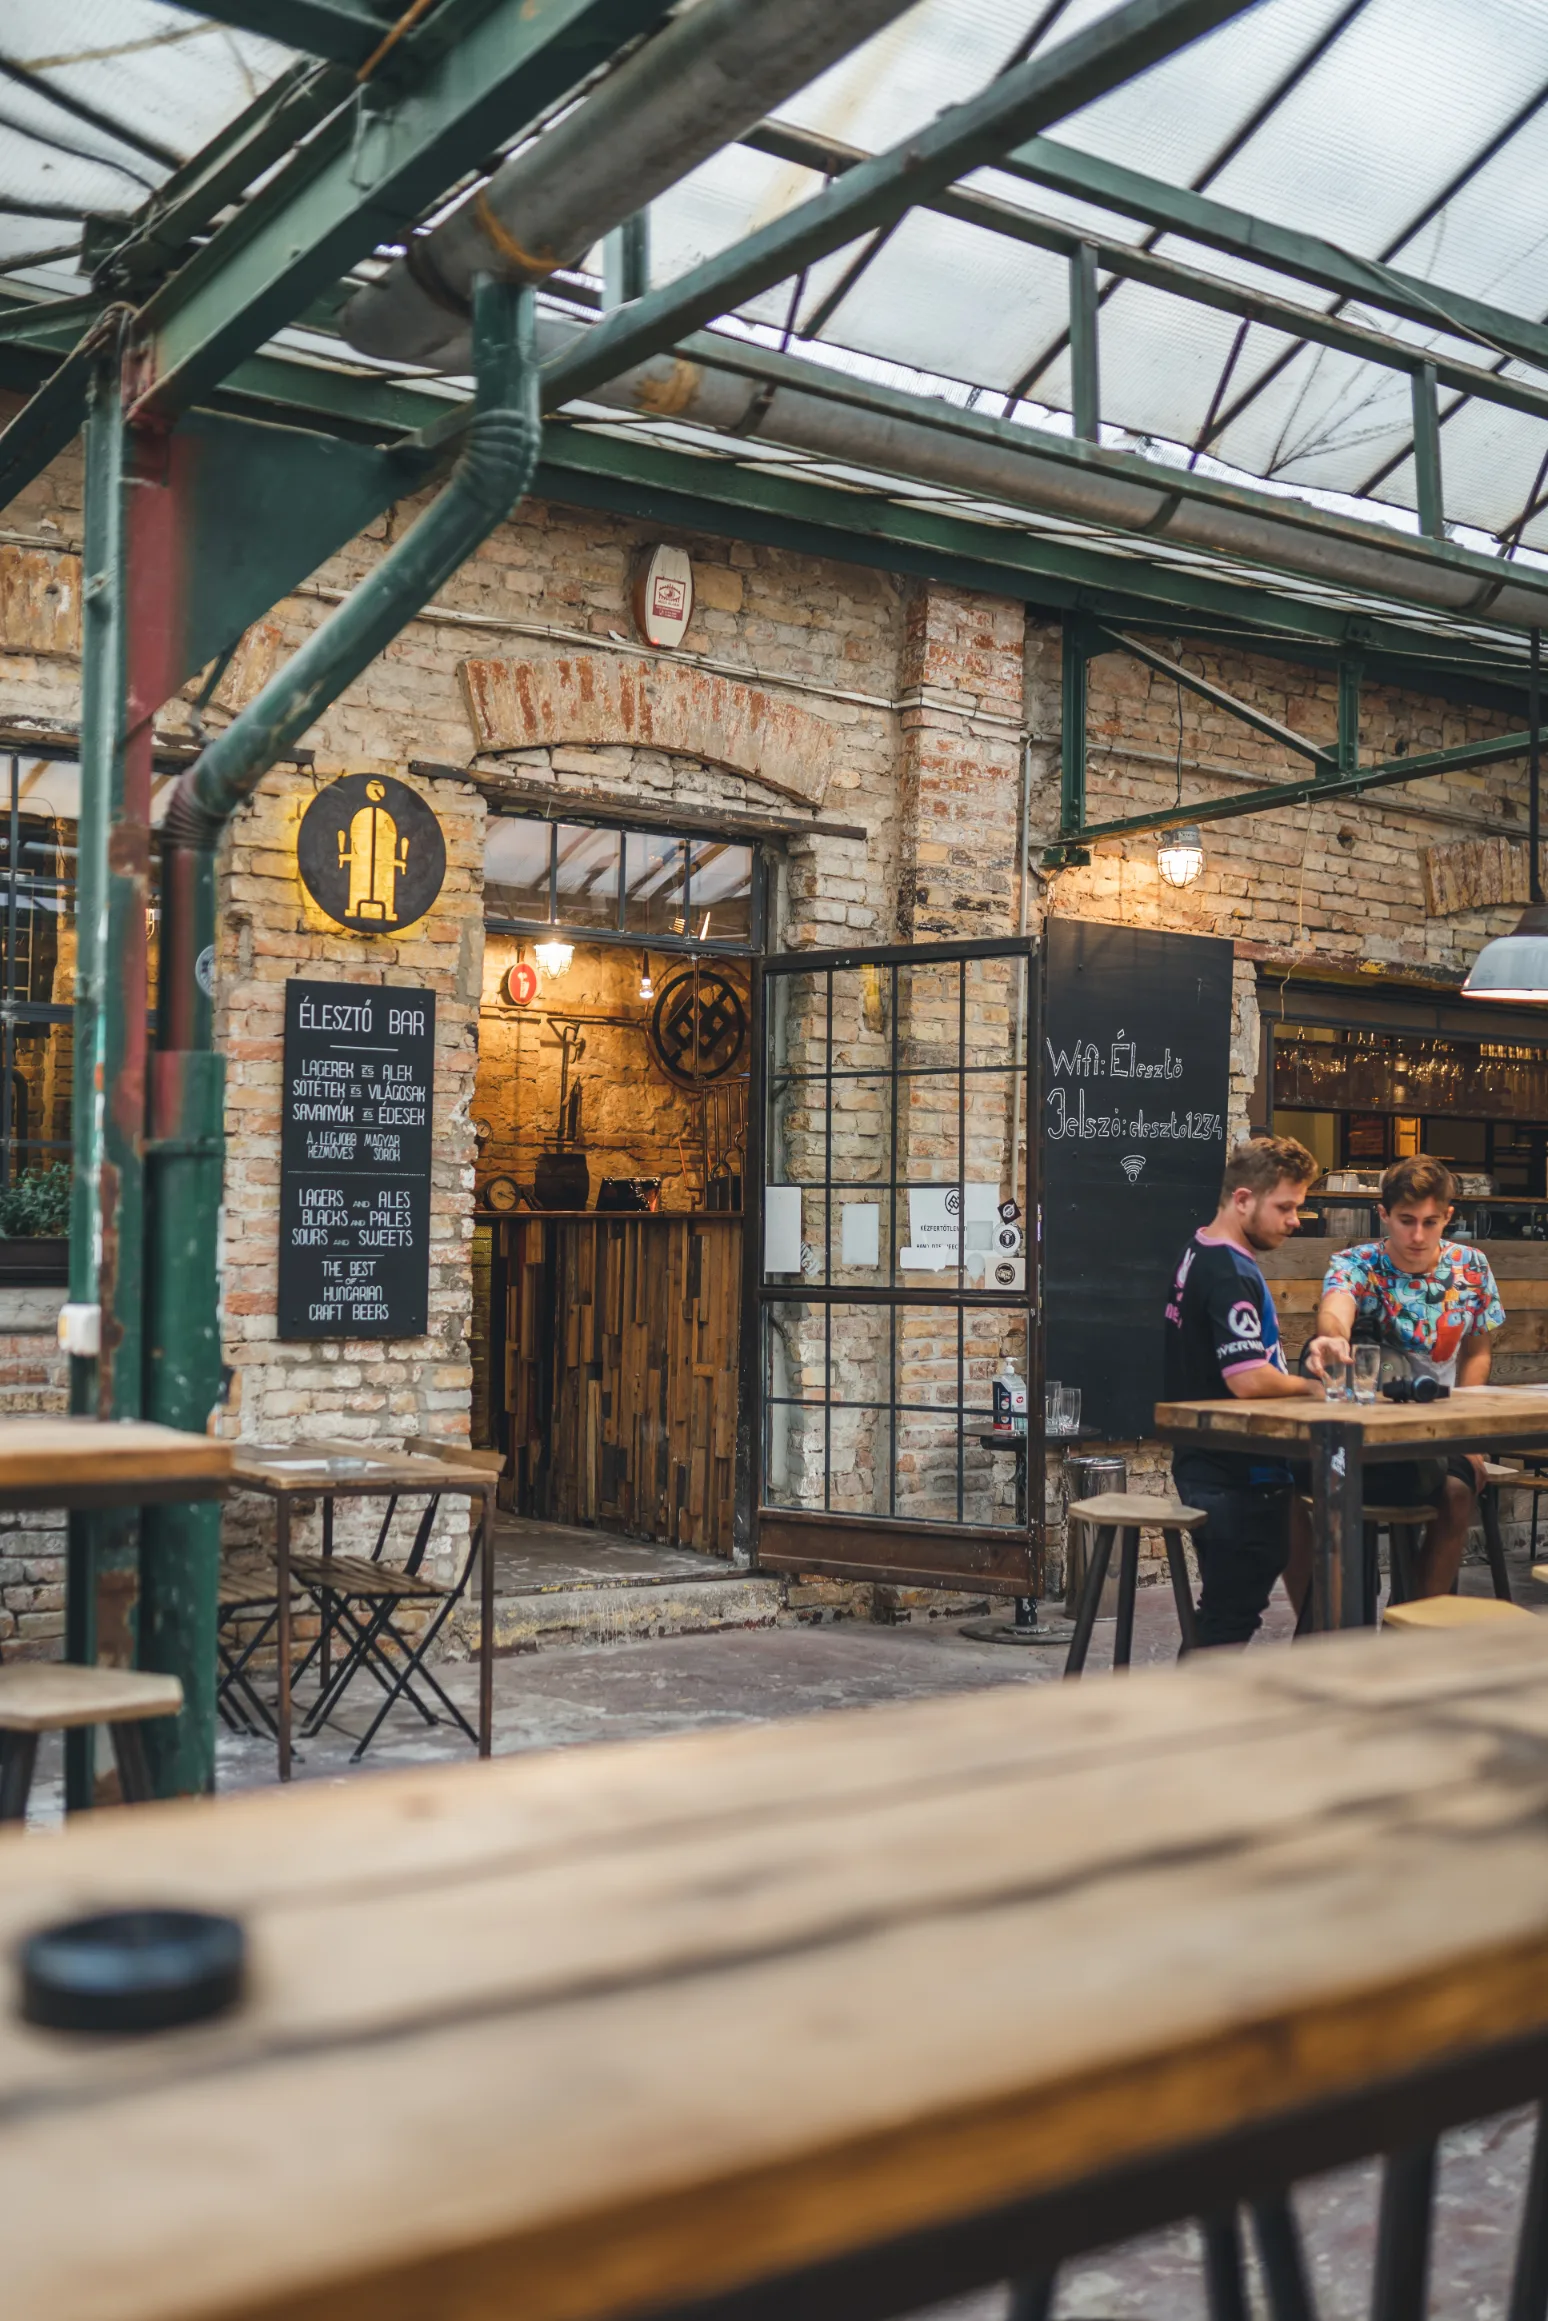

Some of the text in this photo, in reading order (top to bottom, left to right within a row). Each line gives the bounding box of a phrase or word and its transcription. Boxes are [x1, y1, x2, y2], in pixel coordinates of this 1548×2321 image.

[299, 995, 425, 1036] ÉLESZTŐ BAR
[1046, 1037, 1106, 1077] Wifi:
[302, 1059, 354, 1079] LAGEREK
[382, 1064, 412, 1081] ALEK
[368, 1081, 426, 1102] VILÁGOSAK
[292, 1099, 354, 1122] SAVANYÚK
[378, 1101, 425, 1125] ÉDESEK
[306, 1131, 400, 1148] A LEGJOBB MAGYAR
[298, 1188, 411, 1209] LAGERS AND ALES
[302, 1208, 412, 1227] BLACKS AND PALES
[291, 1228, 329, 1246] SOURS
[358, 1229, 413, 1247] SWEETS
[321, 1261, 376, 1277] THE BEST
[323, 1285, 383, 1302] HUNGARIAN
[308, 1304, 389, 1321] CRAFT BEERS
